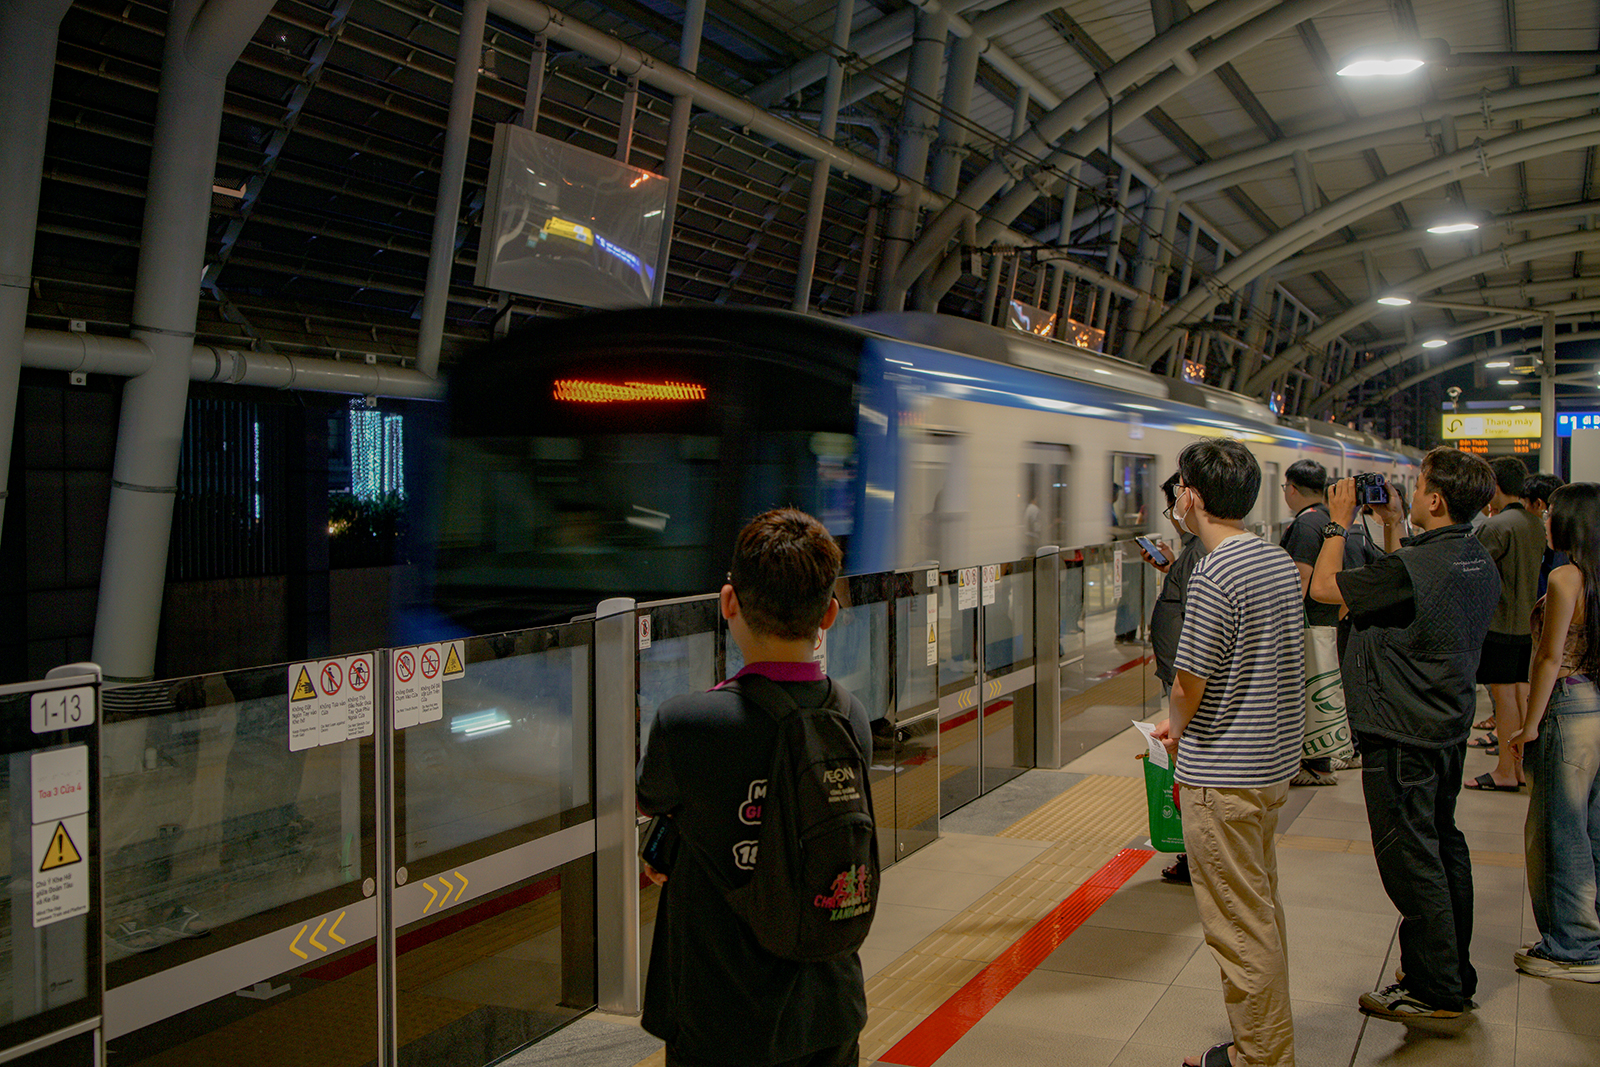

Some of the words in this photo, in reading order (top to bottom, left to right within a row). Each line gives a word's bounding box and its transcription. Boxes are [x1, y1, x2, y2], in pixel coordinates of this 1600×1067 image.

[1486, 418, 1512, 427] Thang
[1514, 418, 1533, 426] máy
[40, 694, 81, 726] 1-13
[38, 790, 52, 799] Toa
[53, 787, 58, 796] 3
[60, 783, 75, 795] Cửa
[77, 782, 82, 790] 4
